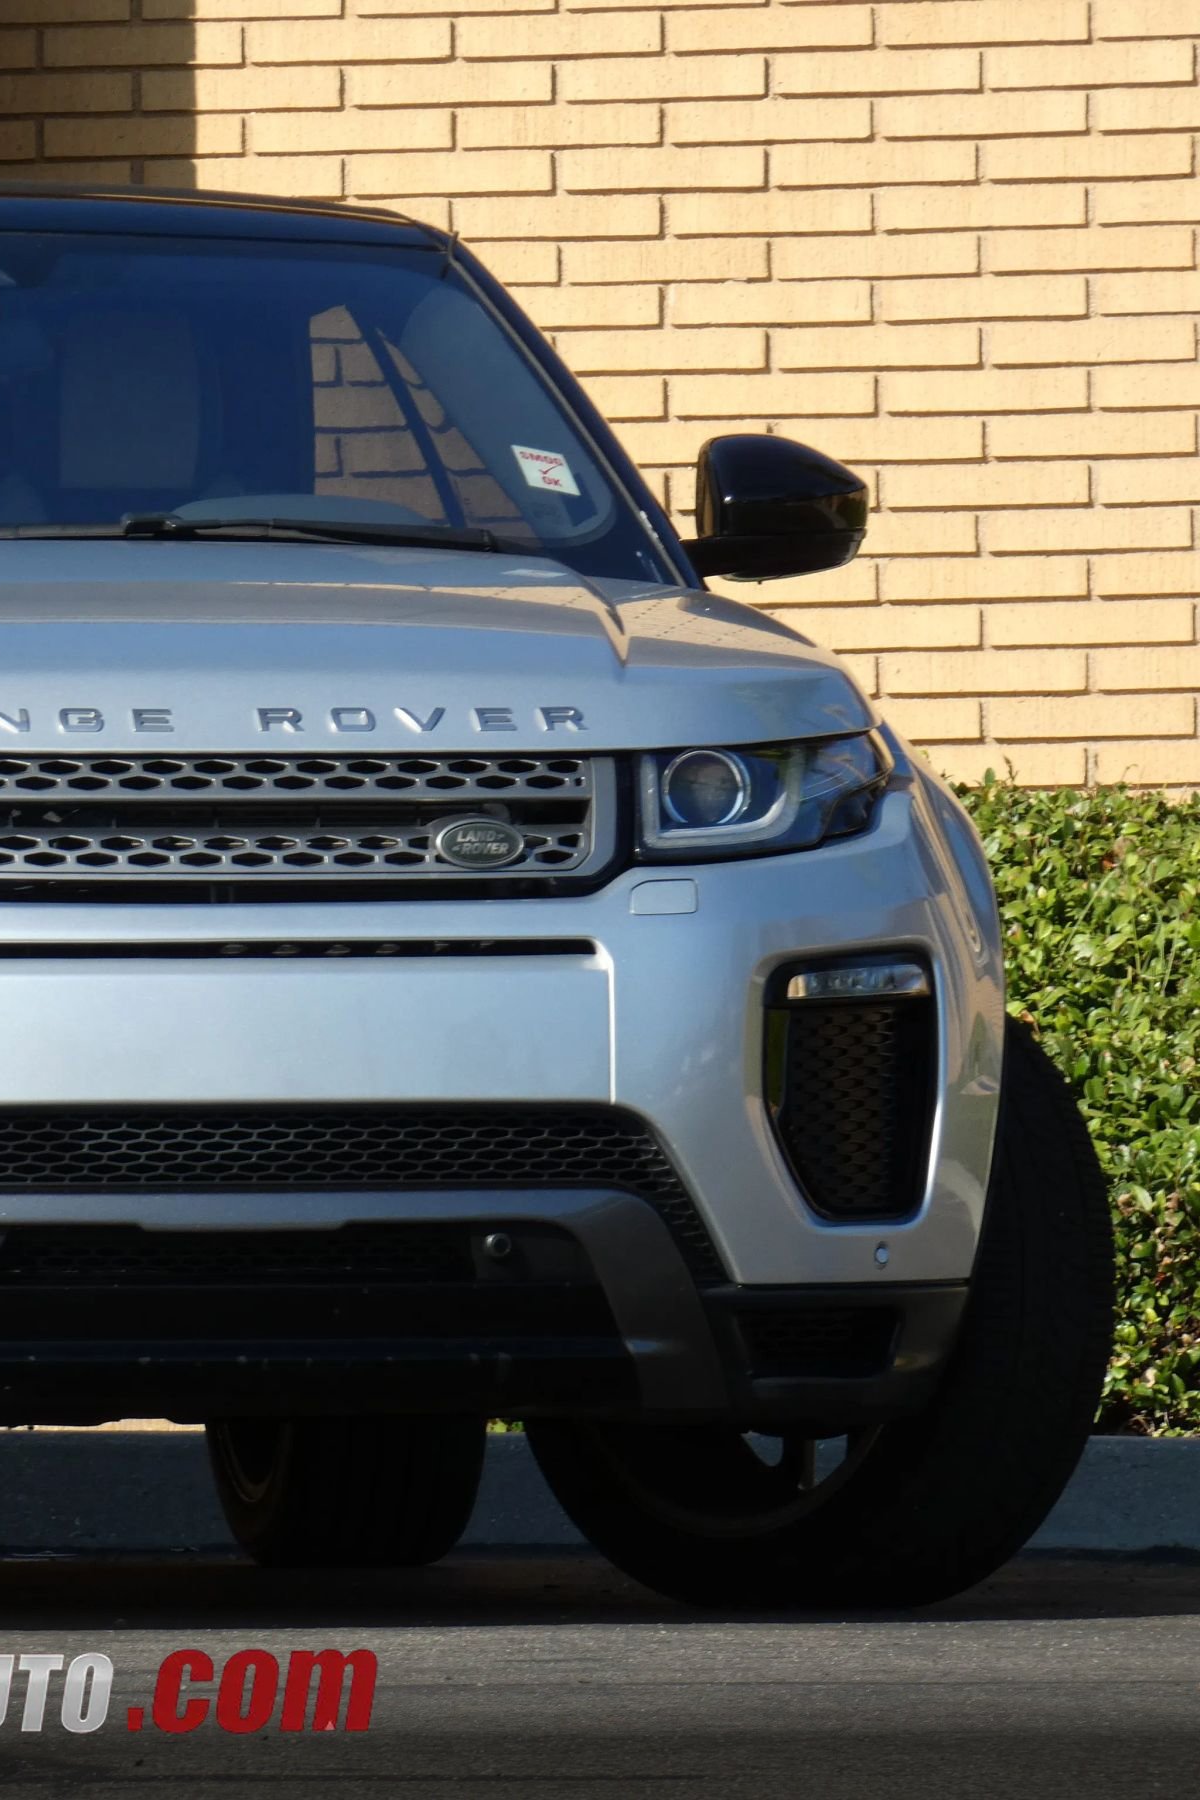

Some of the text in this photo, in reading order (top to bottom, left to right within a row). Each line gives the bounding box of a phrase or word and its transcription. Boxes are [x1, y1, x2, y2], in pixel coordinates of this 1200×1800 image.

[519, 450, 563, 466] SMOG
[541, 476, 562, 487] OK
[253, 706, 589, 733] ROVER
[456, 830, 498, 843] LAND
[459, 842, 510, 855] ROVER
